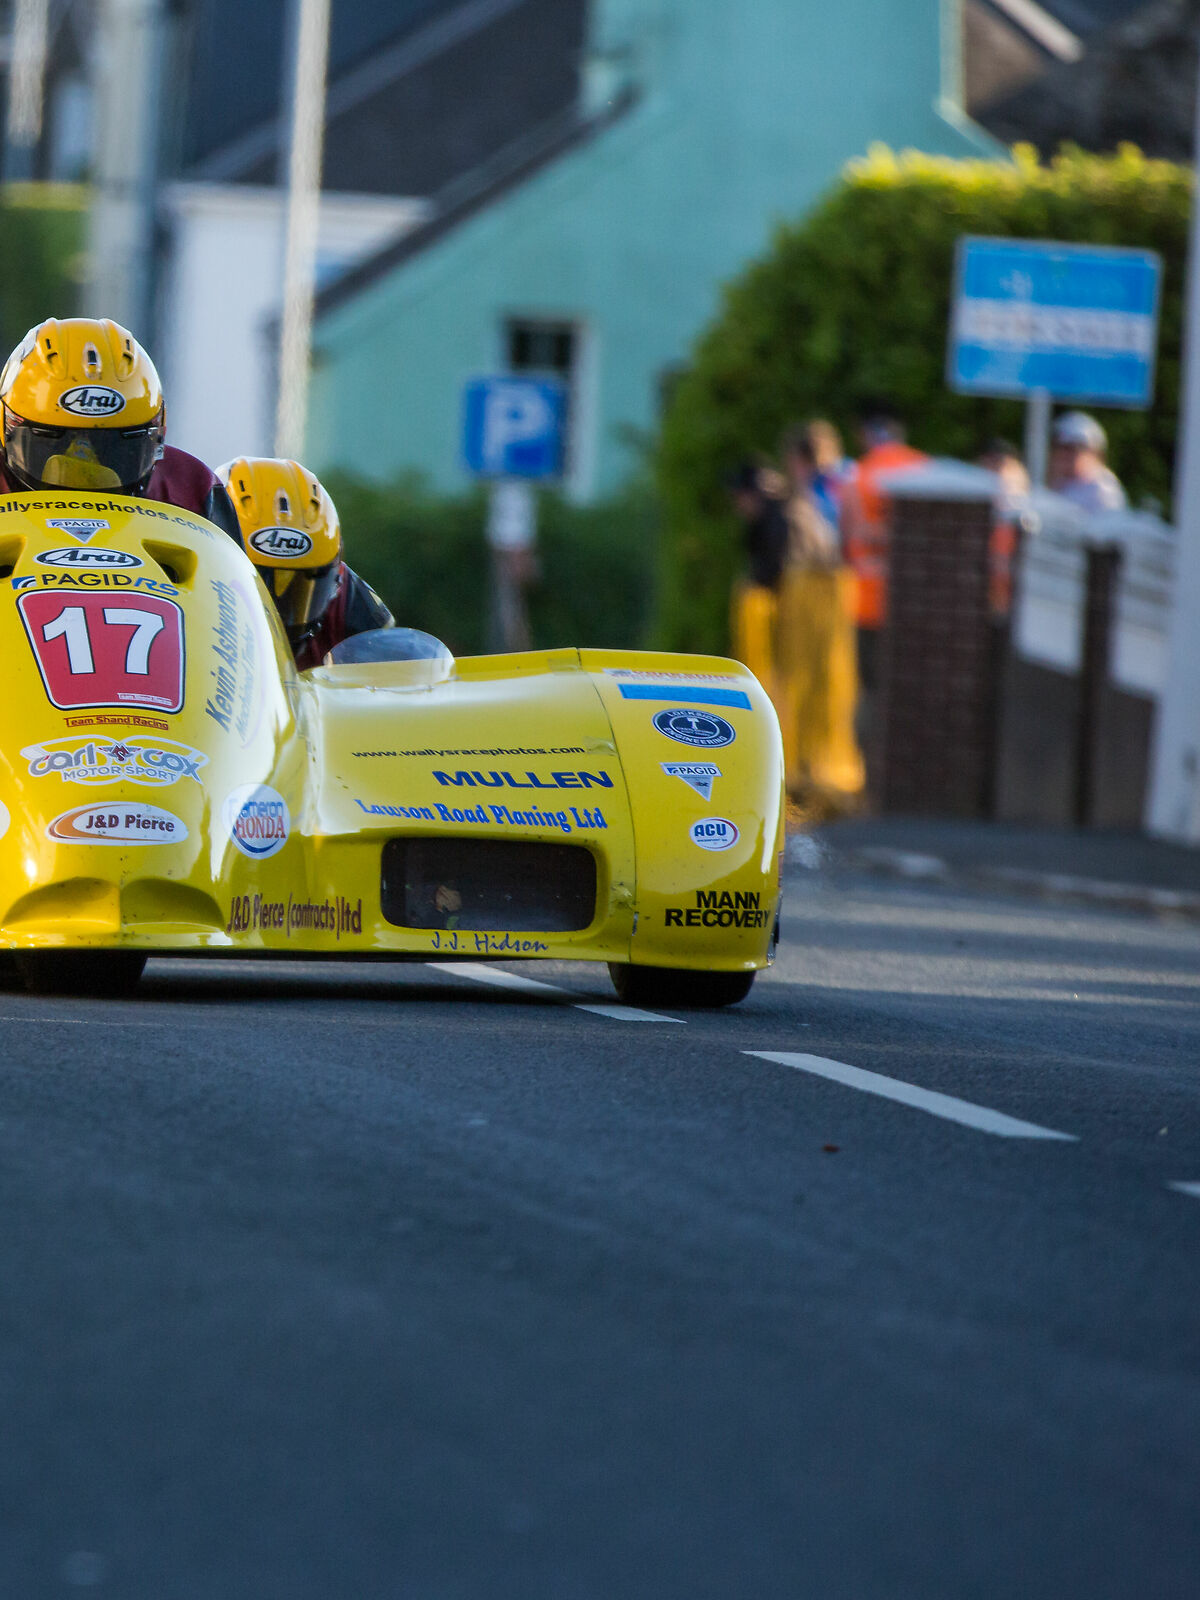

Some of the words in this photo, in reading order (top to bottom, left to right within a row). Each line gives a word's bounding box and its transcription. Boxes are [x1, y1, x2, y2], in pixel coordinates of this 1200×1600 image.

[64, 389, 117, 408] Arai
[482, 386, 548, 470] P
[255, 530, 305, 549] Arai
[46, 549, 127, 563] Arai
[210, 579, 237, 672] Ashworth
[42, 606, 165, 676] 17
[205, 666, 236, 733] Kevin
[64, 715, 93, 728] Team
[96, 715, 130, 727] Shand
[133, 716, 168, 731] Racing
[352, 746, 585, 757] www.wallysracephotos.com
[30, 743, 95, 776] carl
[143, 749, 204, 784] cox
[679, 766, 718, 775] PAGID
[63, 765, 121, 780] MOTOR
[126, 766, 176, 782] SPORT
[432, 771, 614, 788] MULLEN
[85, 815, 120, 829] J&D
[125, 814, 176, 833] Pierce
[353, 799, 435, 820] Lawson
[433, 803, 490, 824] Road
[488, 804, 571, 833] Planing
[569, 807, 608, 829] Ltd
[235, 816, 287, 838] HONDA
[694, 823, 727, 837] ACU
[696, 890, 760, 909] MANN
[226, 896, 250, 933] J&D
[253, 893, 285, 928] Pierce
[664, 908, 771, 928] RECOVERY
[474, 933, 548, 953] Hidson
